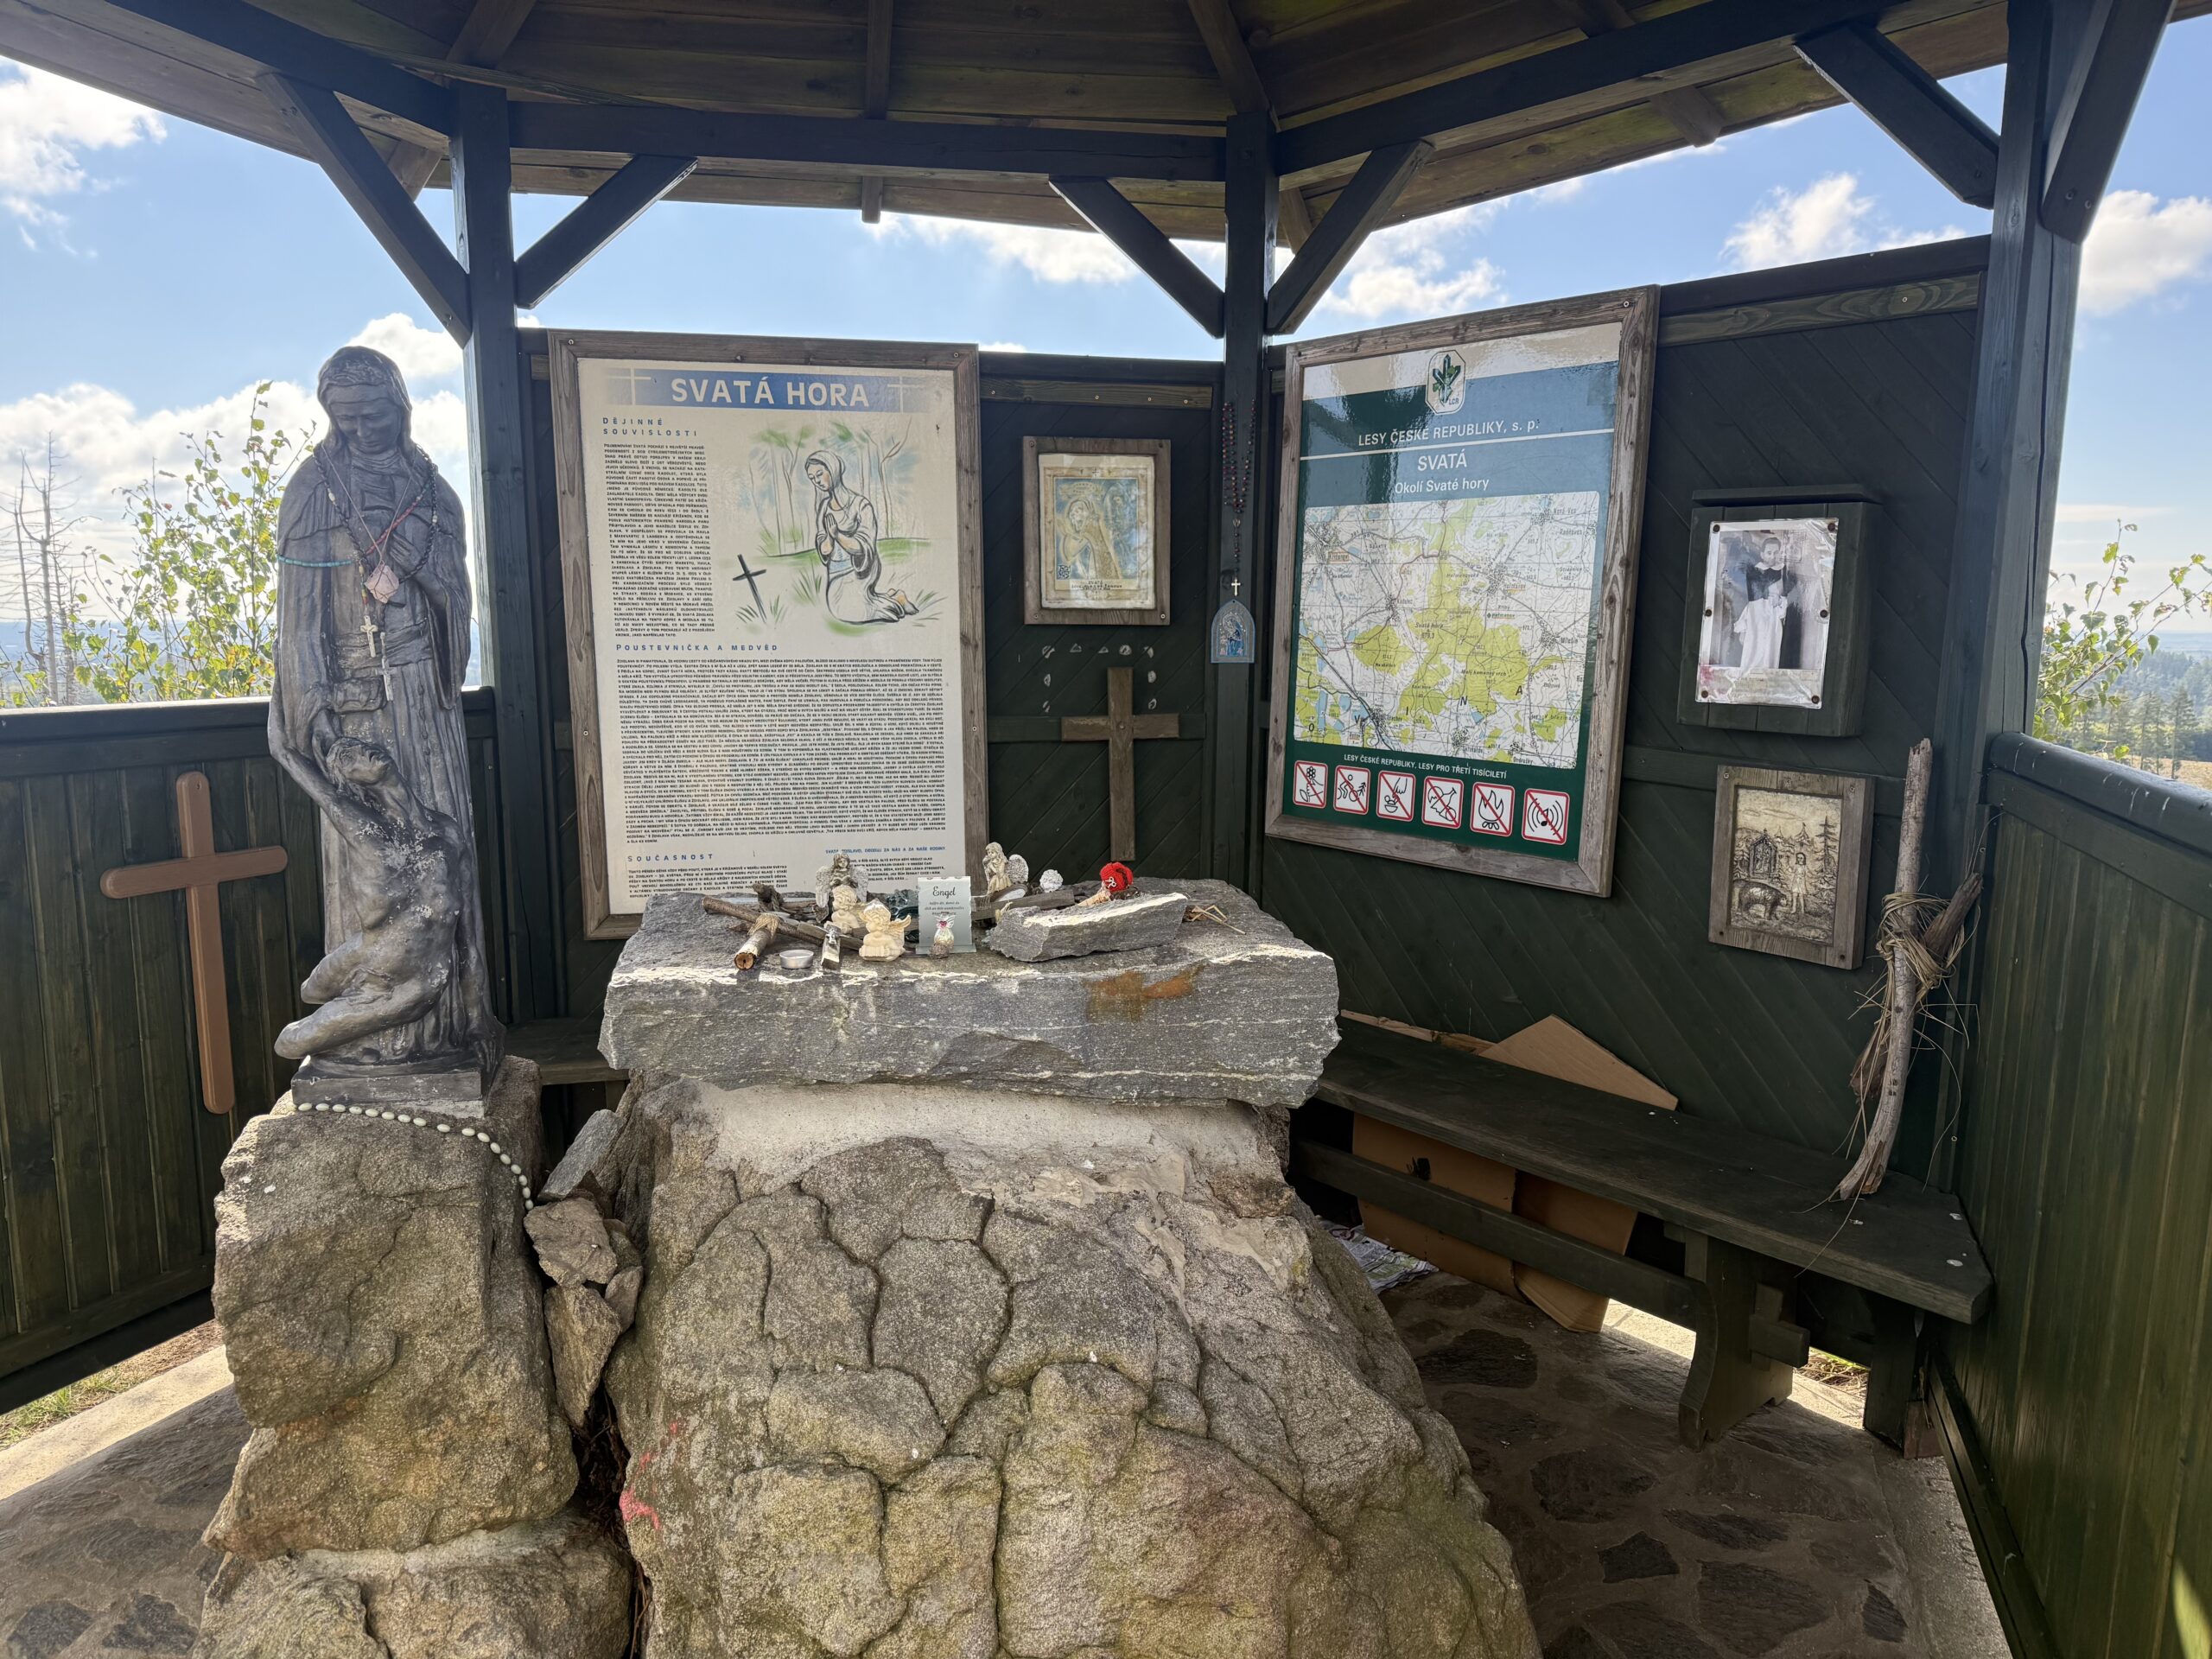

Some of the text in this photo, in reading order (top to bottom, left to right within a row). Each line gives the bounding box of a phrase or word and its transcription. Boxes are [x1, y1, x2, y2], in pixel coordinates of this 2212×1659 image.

[671, 376, 869, 407] SVATÁ HORA
[603, 428, 696, 436] SOUVISLOSTI
[1358, 432, 1386, 446] LESY
[1390, 427, 1429, 443] ČESKÉ
[1433, 420, 1507, 439] REPUBLIKY,
[1511, 422, 1522, 431] s.
[1417, 448, 1467, 472] SVATÁ
[1395, 477, 1489, 493] Okolí Svaté hory
[1344, 753, 1359, 762] LESY
[1359, 754, 1380, 765] ČESKÉ
[1436, 764, 1450, 772] PRO
[1452, 765, 1471, 775] TŘETÍ
[1471, 767, 1508, 779] TISÍCILETÍ
[627, 854, 713, 862] SOUČASNOST
[932, 886, 956, 899] Engel
